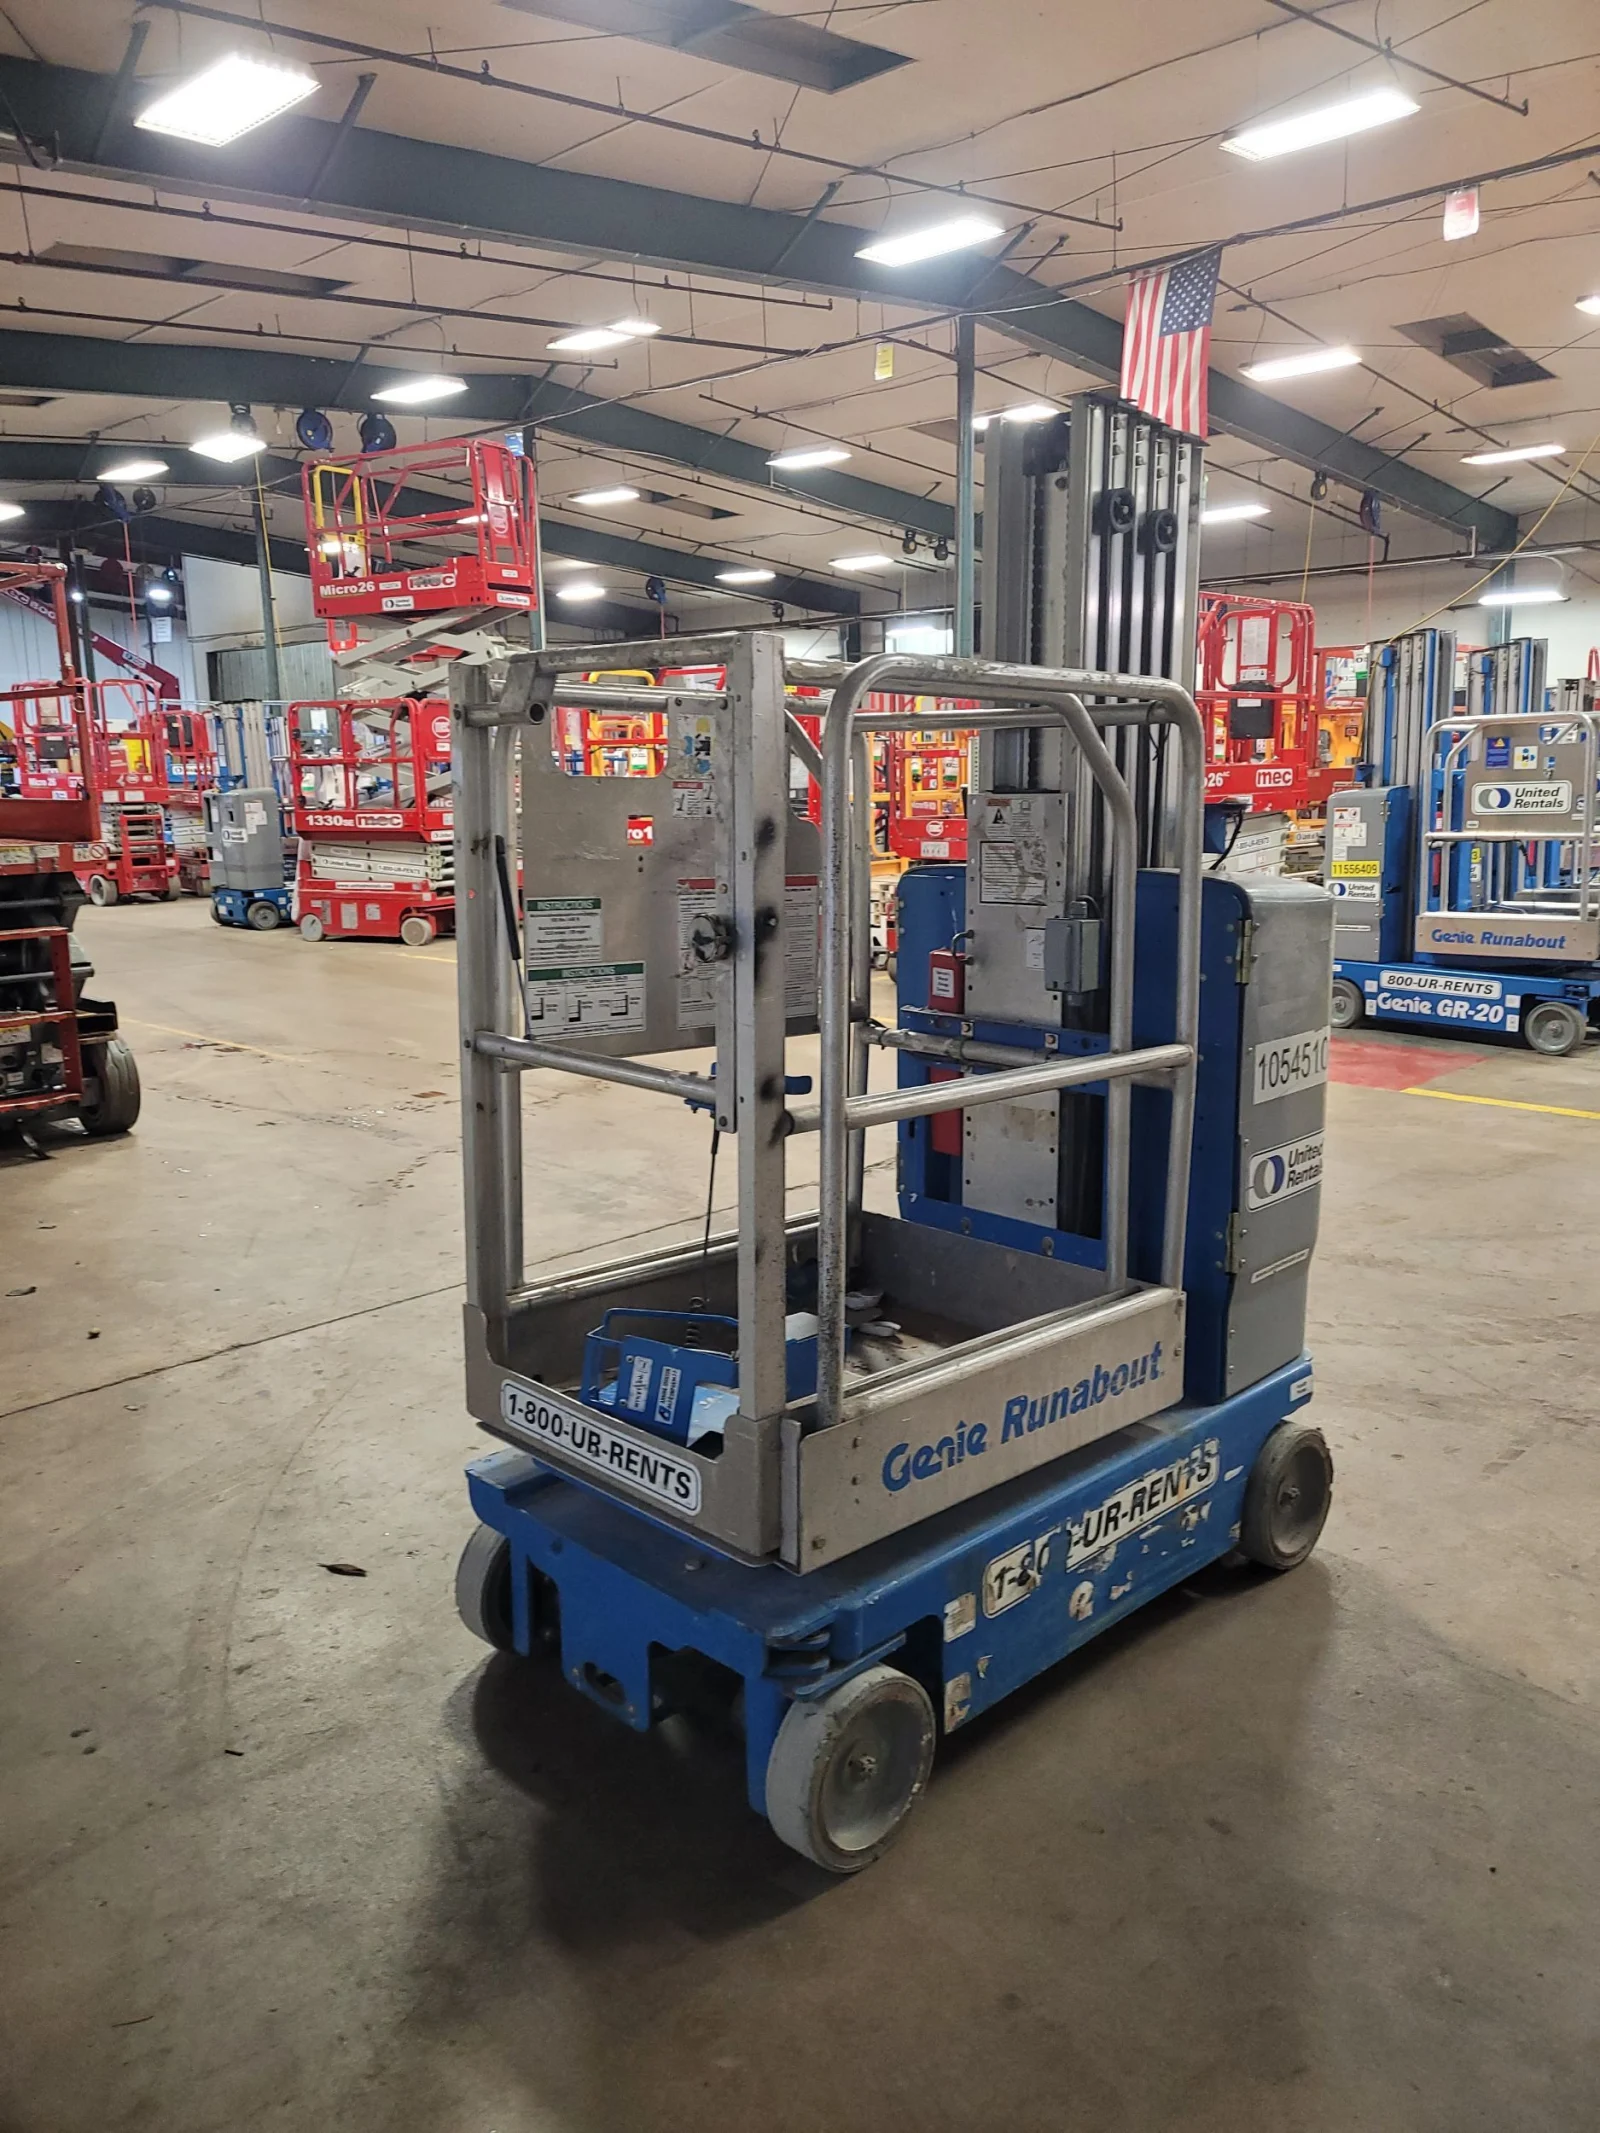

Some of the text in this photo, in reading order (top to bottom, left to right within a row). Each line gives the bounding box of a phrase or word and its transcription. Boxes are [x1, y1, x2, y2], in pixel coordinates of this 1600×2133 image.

[320, 581, 376, 597] Micro26
[1257, 770, 1292, 785] mec
[1515, 787, 1561, 798] United
[1514, 798, 1564, 809] Rentals
[1333, 863, 1378, 875] 11556409
[1348, 882, 1375, 891] United
[1348, 890, 1376, 899] Rentals
[1431, 928, 1567, 950] Genie Runabout
[1387, 974, 1494, 995] 800-UR-RENTS
[1376, 991, 1504, 1024] Genie GR-20
[881, 1340, 1163, 1493] Genie Runabout
[508, 1393, 691, 1499] 1-800-UR-RENTS
